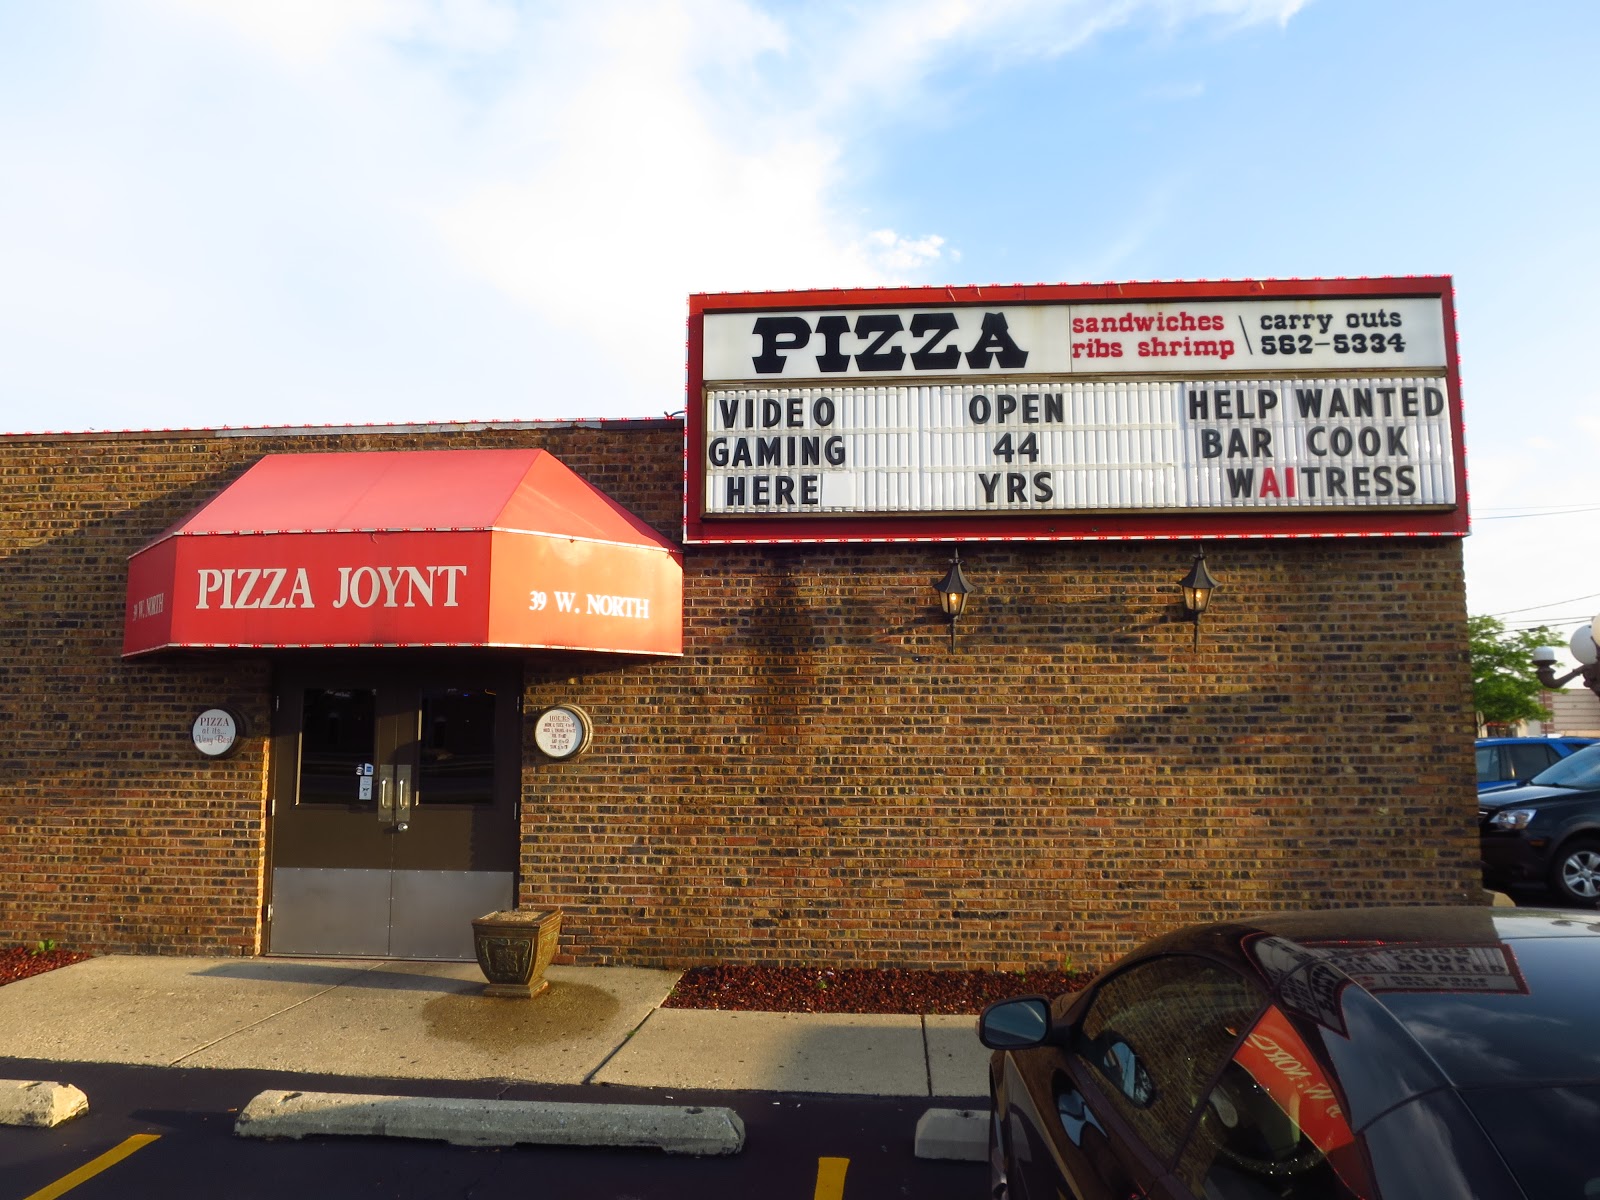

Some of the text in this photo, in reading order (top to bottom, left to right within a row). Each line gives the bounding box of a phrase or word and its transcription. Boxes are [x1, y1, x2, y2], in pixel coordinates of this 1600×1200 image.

[1072, 312, 1225, 333] sandwiches
[1260, 309, 1403, 334] carry outs
[752, 312, 1029, 373] PIZZA
[1072, 336, 1235, 360] ribs shrimp
[1261, 333, 1406, 355] 562-5334
[719, 396, 835, 429] VIDEO
[968, 393, 1064, 424] OPEN
[1189, 387, 1444, 420] HELP WANTED
[708, 435, 846, 467] GAMING
[993, 432, 1039, 463] 44
[1201, 425, 1408, 459] BAR COOK
[727, 475, 819, 506] HERE
[979, 471, 1053, 503] YRS
[1227, 465, 1416, 498] WAITRESS
[196, 565, 467, 609] PIZZA JOYNT
[146, 592, 164, 616] NORTH
[528, 590, 650, 619] 39 W. NORTH
[200, 717, 230, 727] PIZZA
[214, 734, 233, 744] Best
